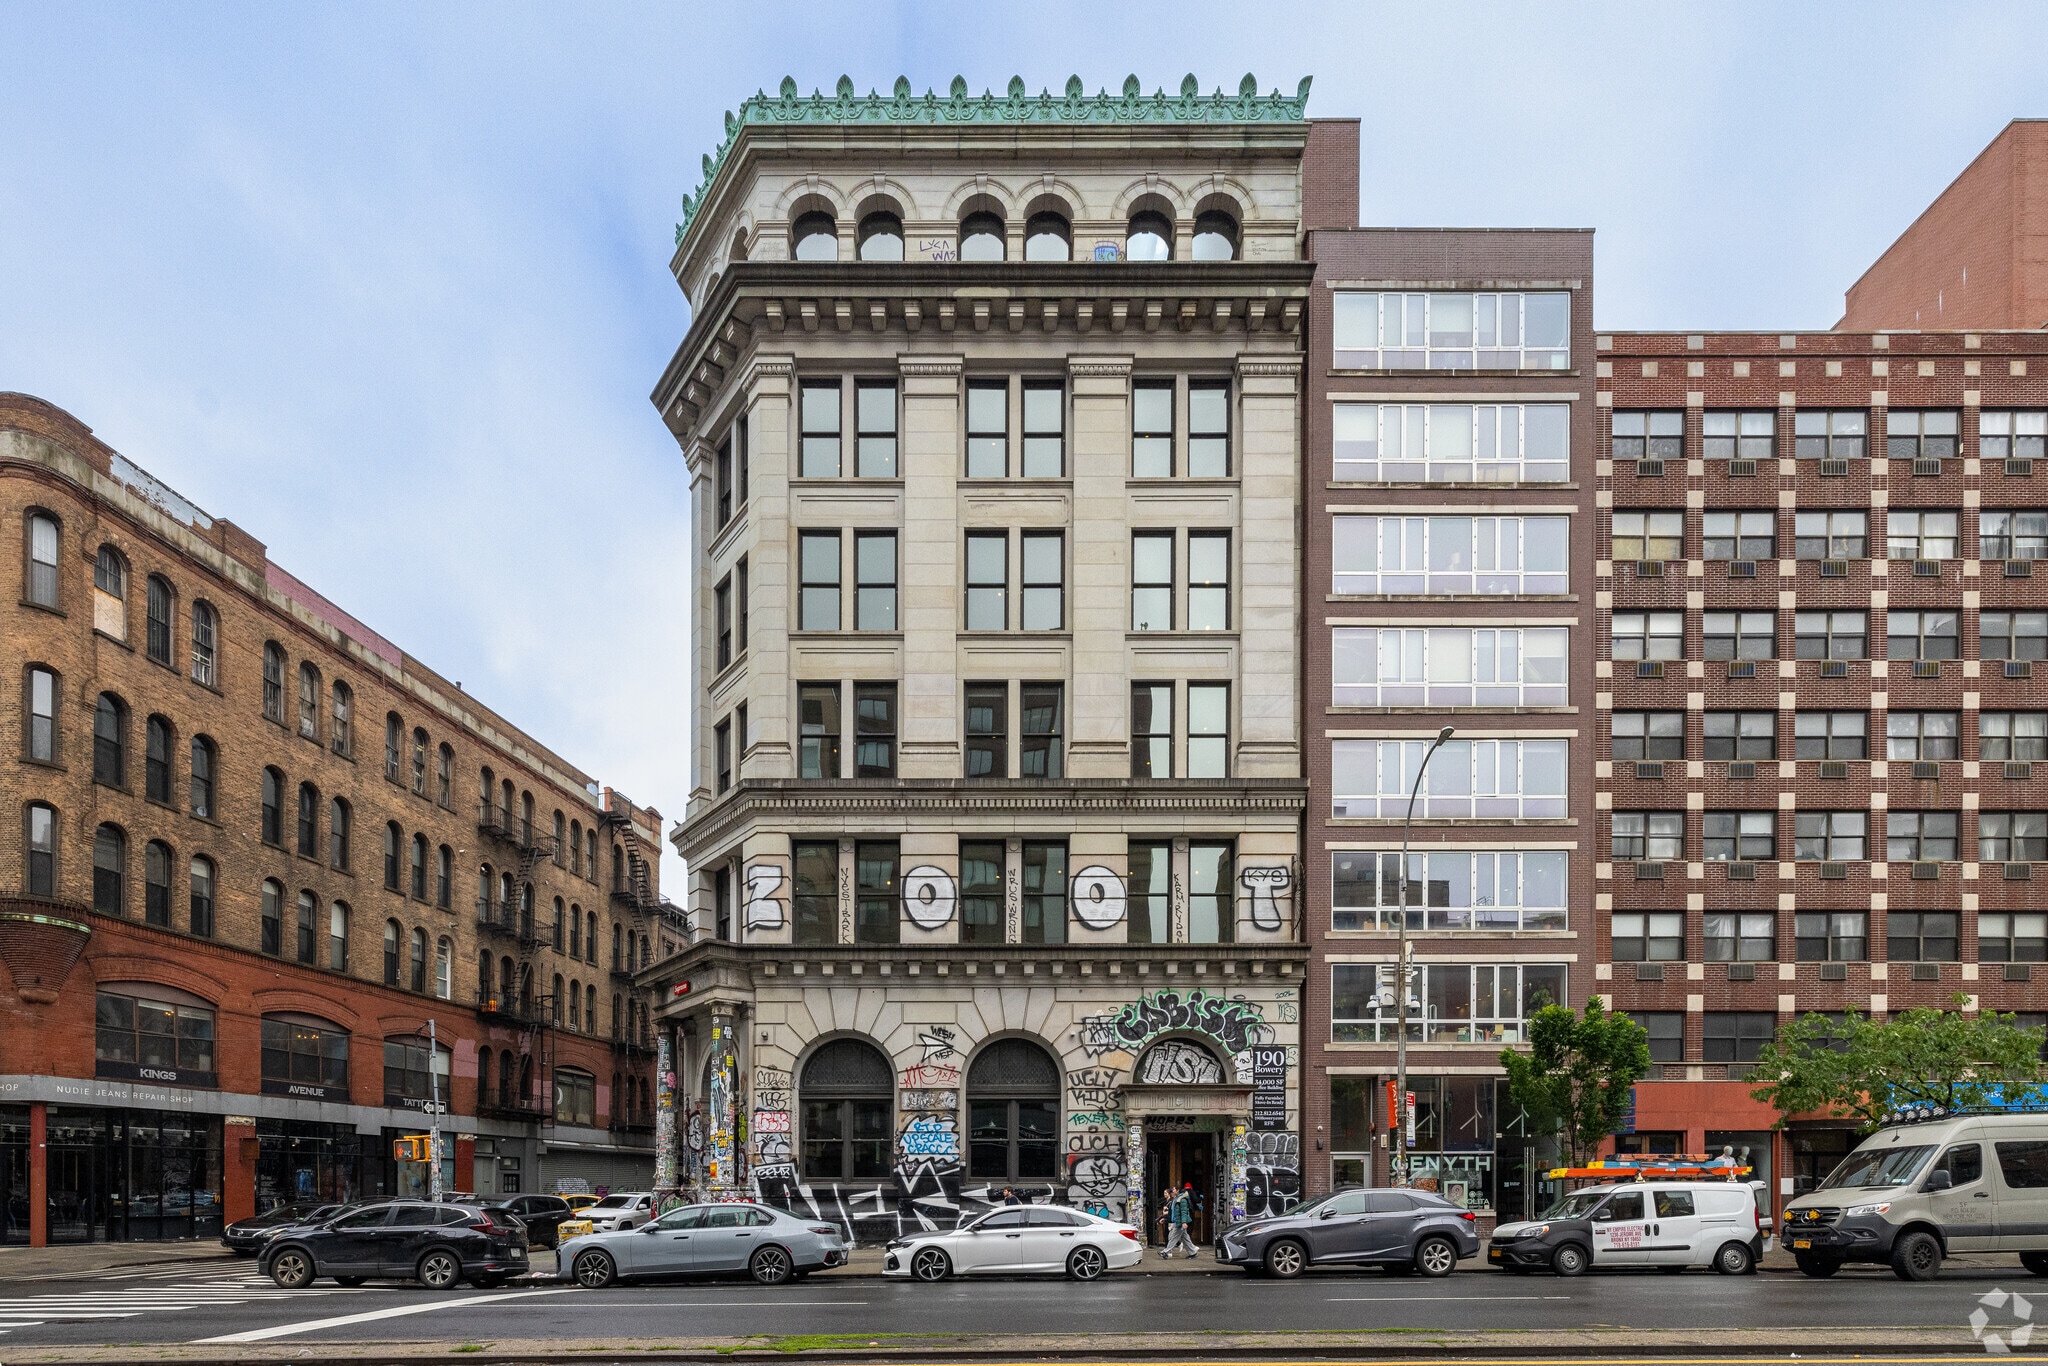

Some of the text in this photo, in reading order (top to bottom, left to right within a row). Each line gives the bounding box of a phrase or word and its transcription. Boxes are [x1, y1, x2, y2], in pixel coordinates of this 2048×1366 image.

[1255, 1050, 1285, 1067] 190
[140, 1068, 177, 1081] KINGS
[1255, 1066, 1284, 1075] Bowery
[1069, 1070, 1119, 1089] UGLY
[56, 1085, 90, 1096] NUDIE
[96, 1089, 128, 1099] JEANS
[132, 1092, 166, 1101] REPAIR
[170, 1096, 194, 1104] SHOP
[288, 1085, 325, 1097] AVENUE
[1071, 1089, 1125, 1110] KIDS
[903, 1134, 954, 1145] UPSCALE
[1391, 1156, 1491, 1172] GENYTH
